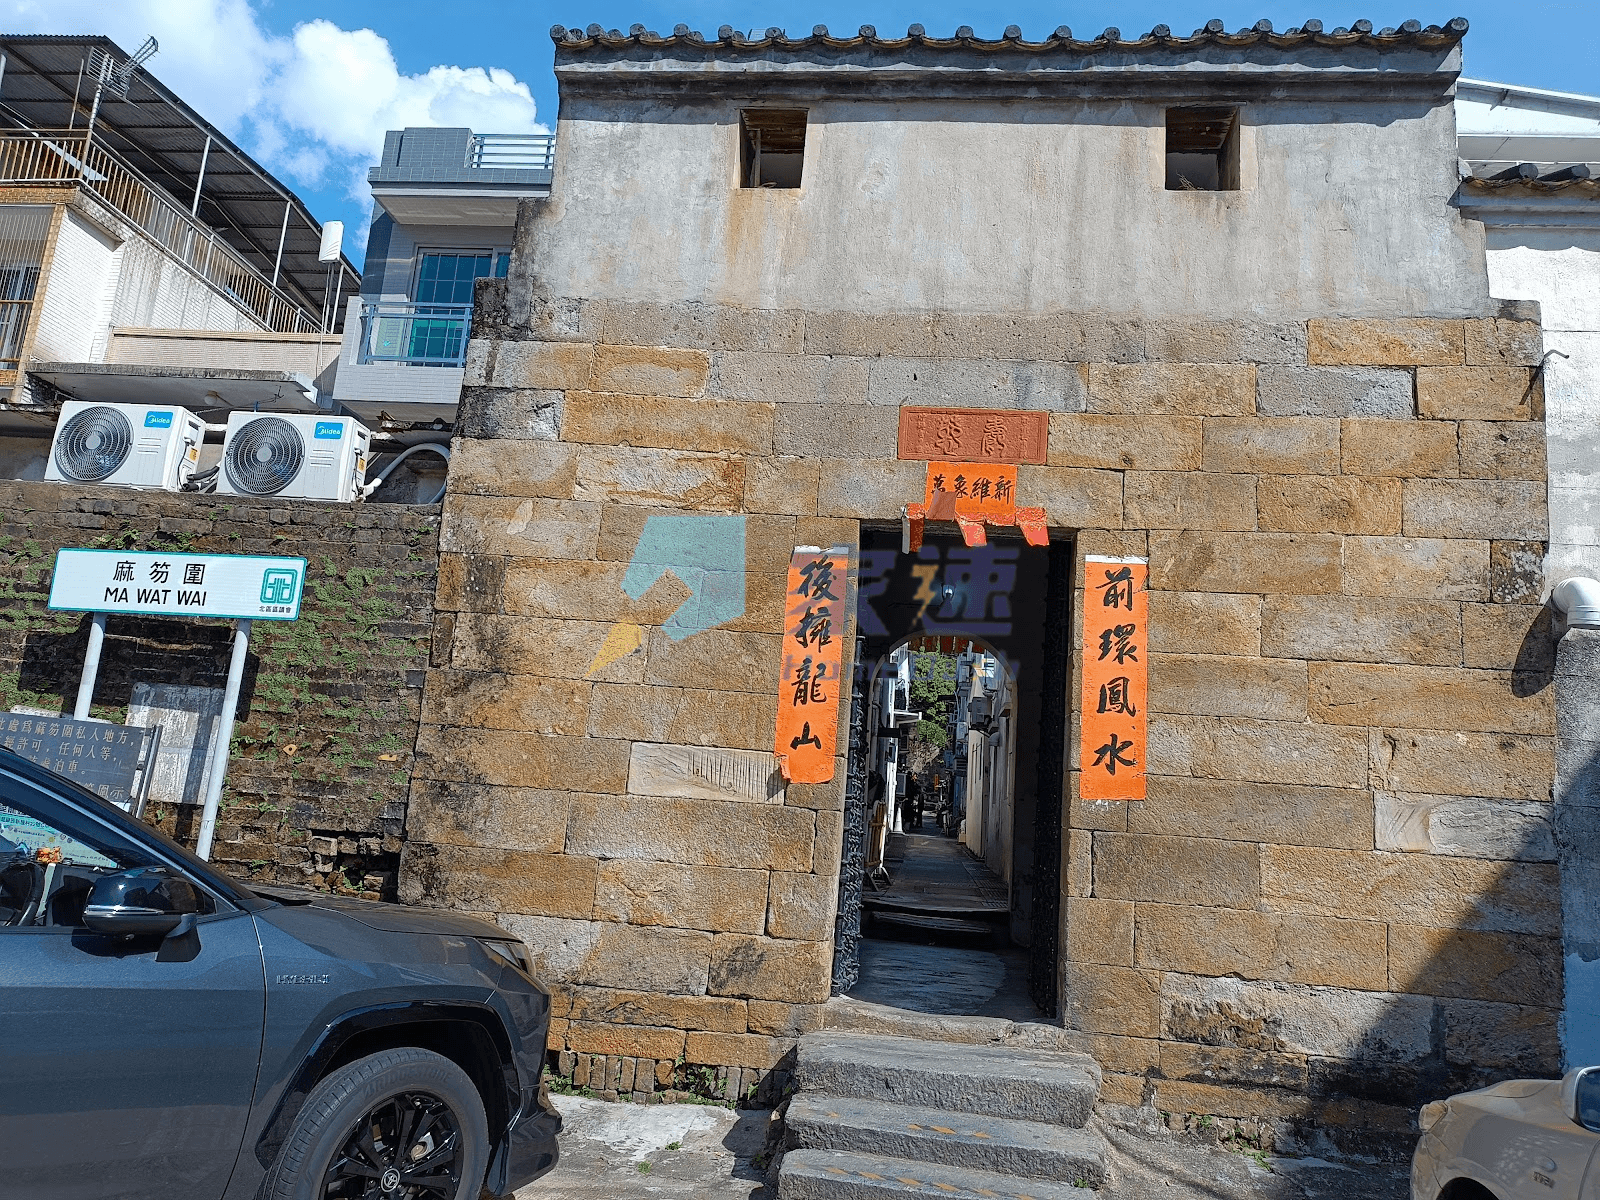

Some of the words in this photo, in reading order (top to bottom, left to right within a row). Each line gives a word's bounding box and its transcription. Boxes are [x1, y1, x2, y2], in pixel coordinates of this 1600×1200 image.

[317, 425, 341, 435] Midea
[112, 560, 206, 585] 麻笏圍
[104, 586, 129, 603] MA
[137, 588, 171, 605] WAT
[177, 590, 207, 606] WAI
[1091, 567, 1139, 776] 前環鳳水
